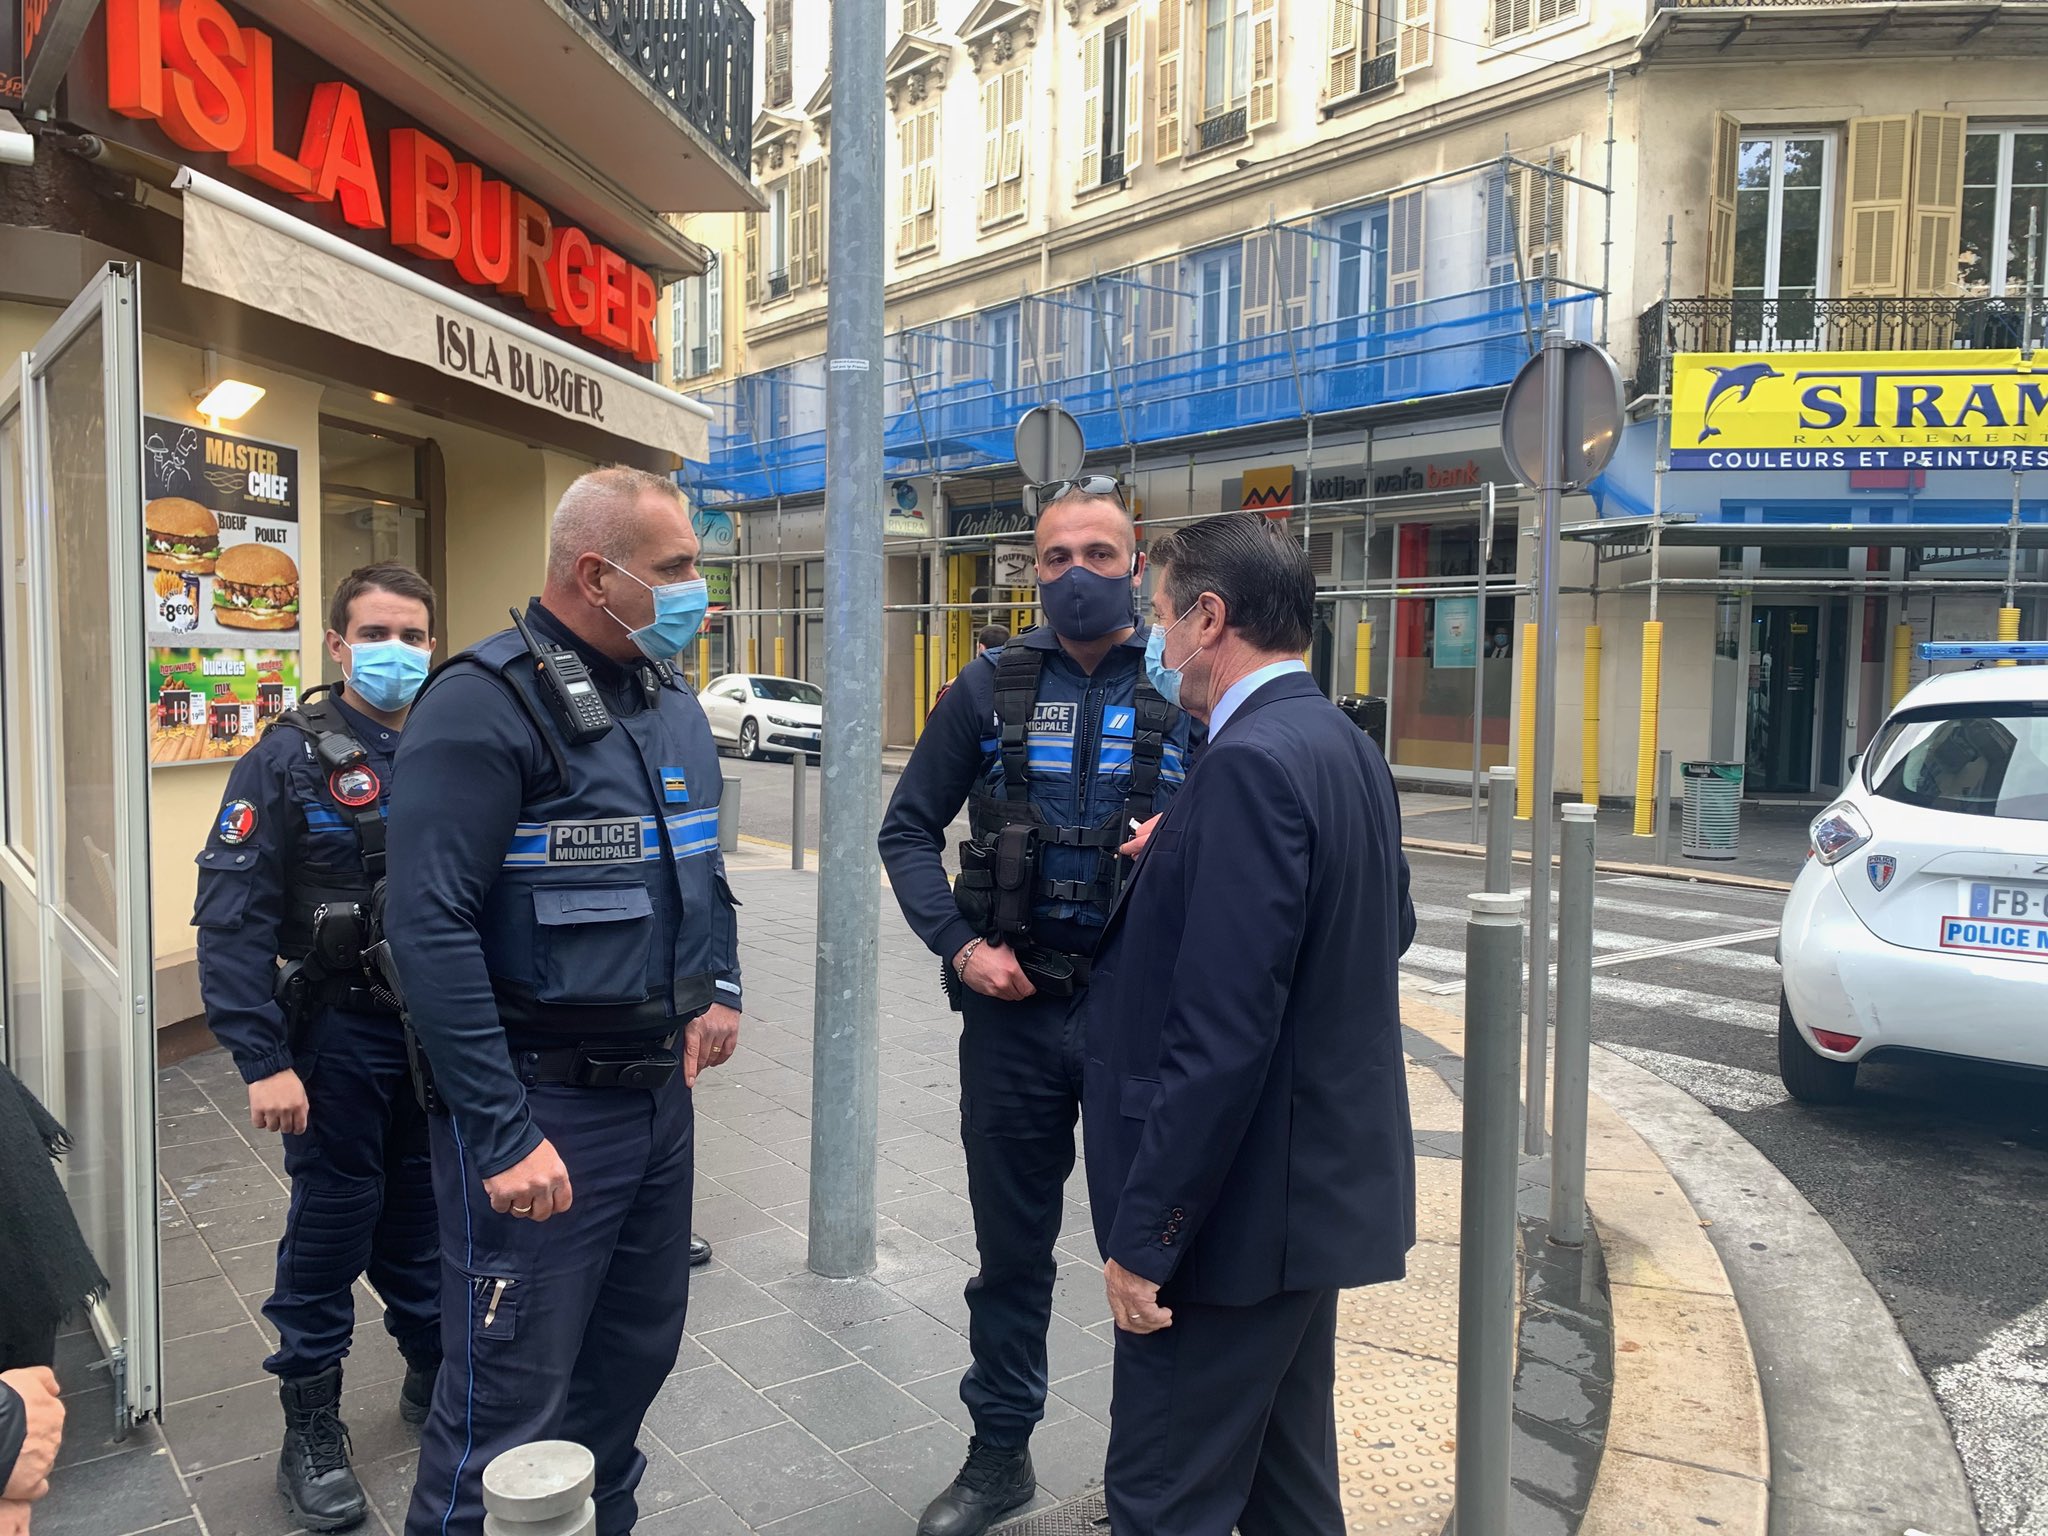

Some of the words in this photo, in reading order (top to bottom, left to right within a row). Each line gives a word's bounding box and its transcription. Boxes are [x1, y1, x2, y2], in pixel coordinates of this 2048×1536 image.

[107, 0, 386, 229] ISLA
[390, 127, 661, 363] BURGER
[436, 314, 502, 387] ISLA
[509, 345, 605, 424] BURGER
[205, 437, 278, 475] MASTER
[1708, 451, 1845, 469] COULEURS
[1859, 451, 1889, 468] ET
[1427, 459, 1479, 488] bank
[248, 471, 288, 501] CHEF
[217, 512, 248, 530] BOEUF
[888, 519, 927, 533] RIVIERA
[254, 526, 287, 543] POULET
[165, 604, 194, 622] 8€90
[202, 656, 246, 676] buckets
[214, 682, 232, 696] mix
[1032, 706, 1069, 721] LICE
[1026, 721, 1068, 732] NICIPALE
[555, 824, 636, 845] POLICE
[555, 844, 636, 860] MUNICIPALE
[1947, 922, 2030, 948] POLICE
